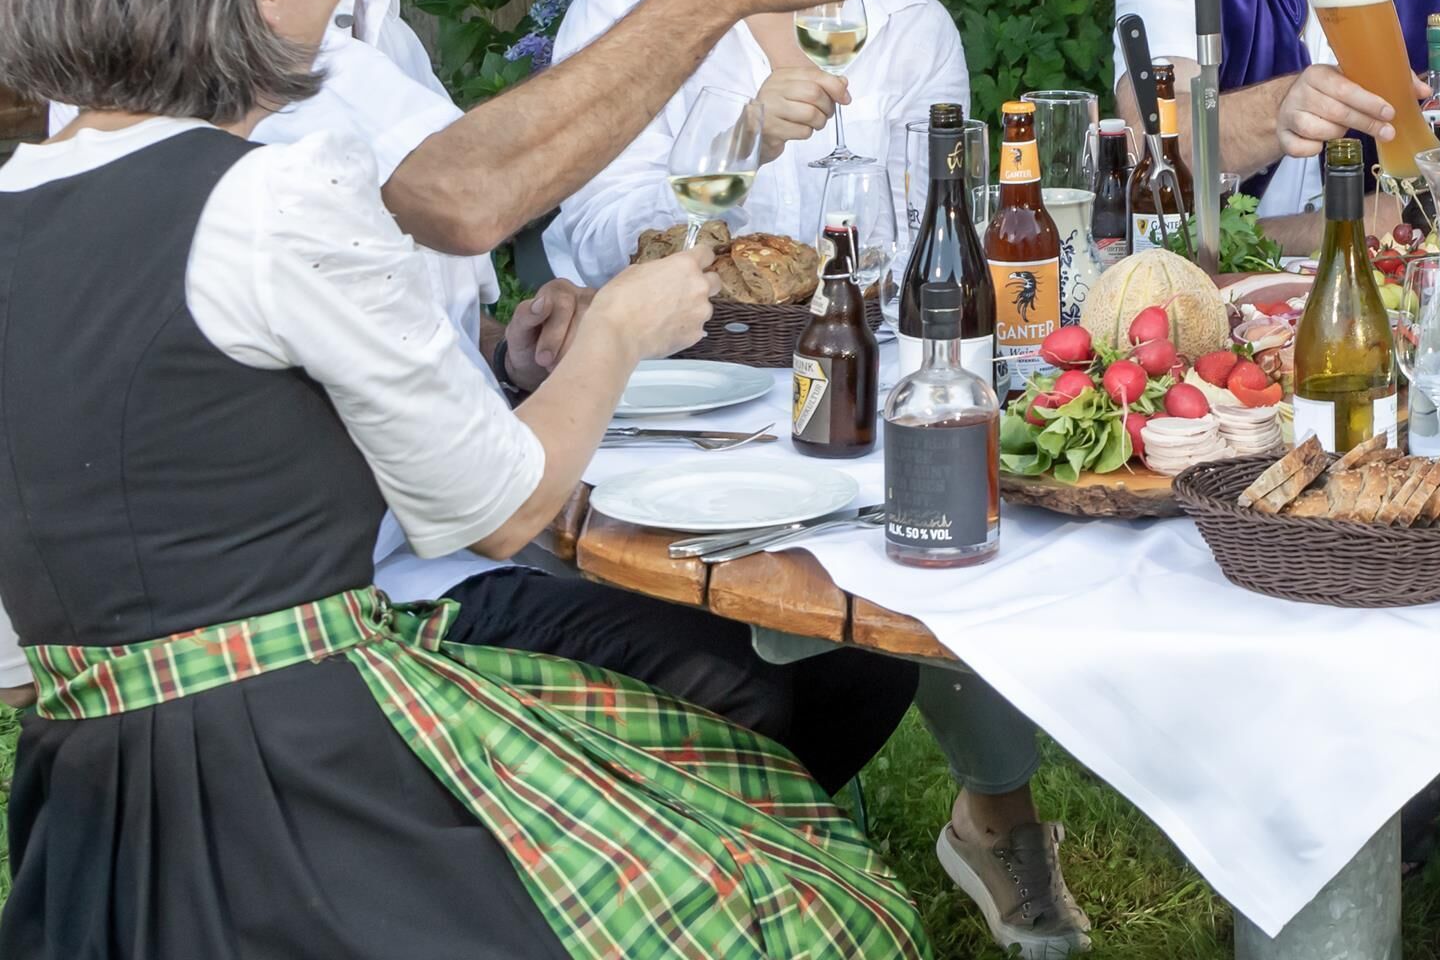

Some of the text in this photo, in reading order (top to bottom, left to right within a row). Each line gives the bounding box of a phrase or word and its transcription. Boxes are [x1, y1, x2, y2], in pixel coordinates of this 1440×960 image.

[1151, 219, 1182, 230] GNTE
[997, 319, 1054, 340] GANTER
[905, 527, 919, 539] 50
[919, 529, 929, 540] %
[929, 528, 953, 540] VOL
